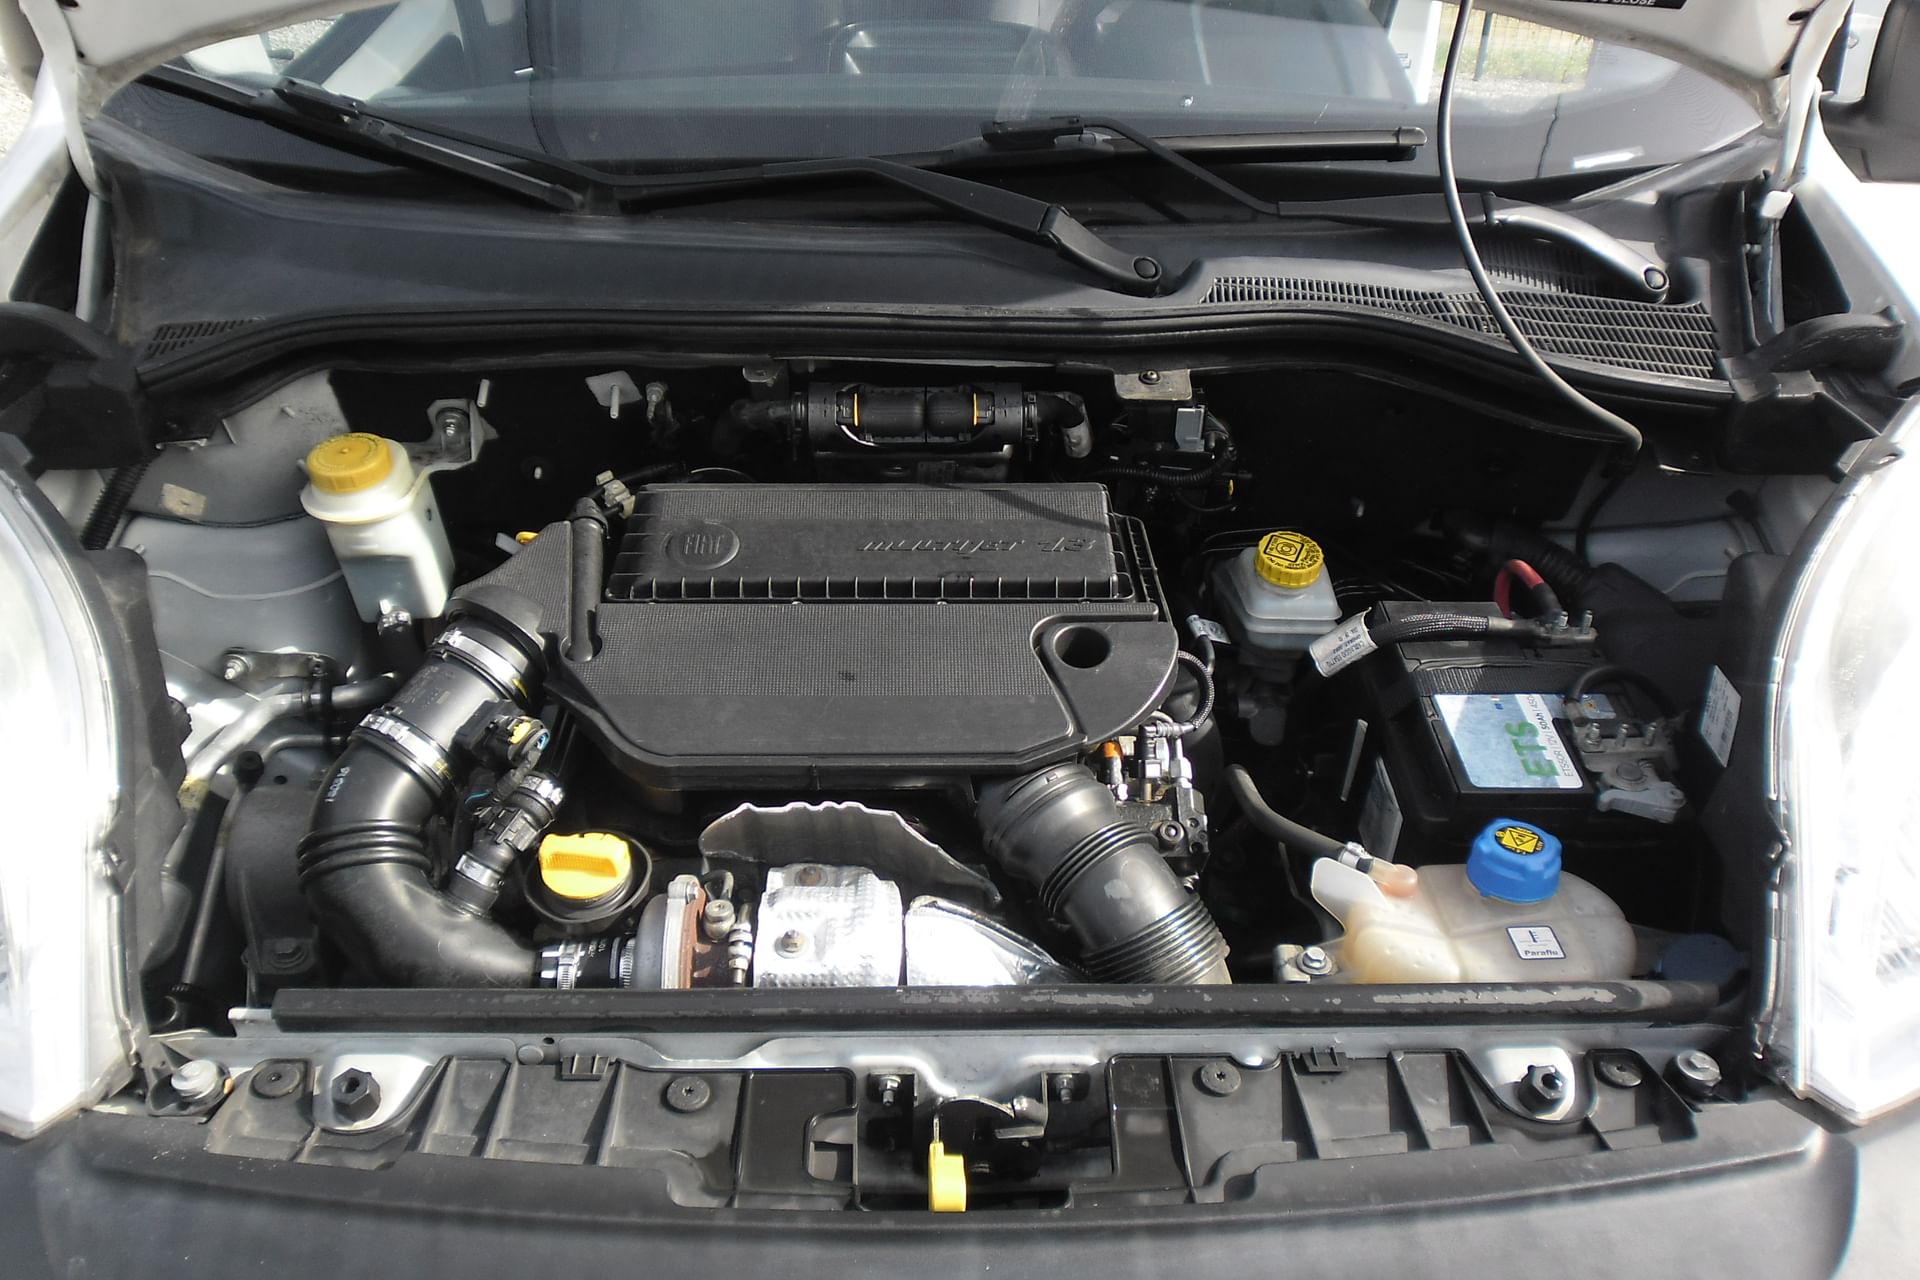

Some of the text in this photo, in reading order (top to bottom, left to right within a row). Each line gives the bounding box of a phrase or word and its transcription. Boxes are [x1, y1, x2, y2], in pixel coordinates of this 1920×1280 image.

[683, 533, 725, 555] FIAT
[1536, 711, 1550, 730] 50Ah
[1504, 721, 1560, 777] ETS
